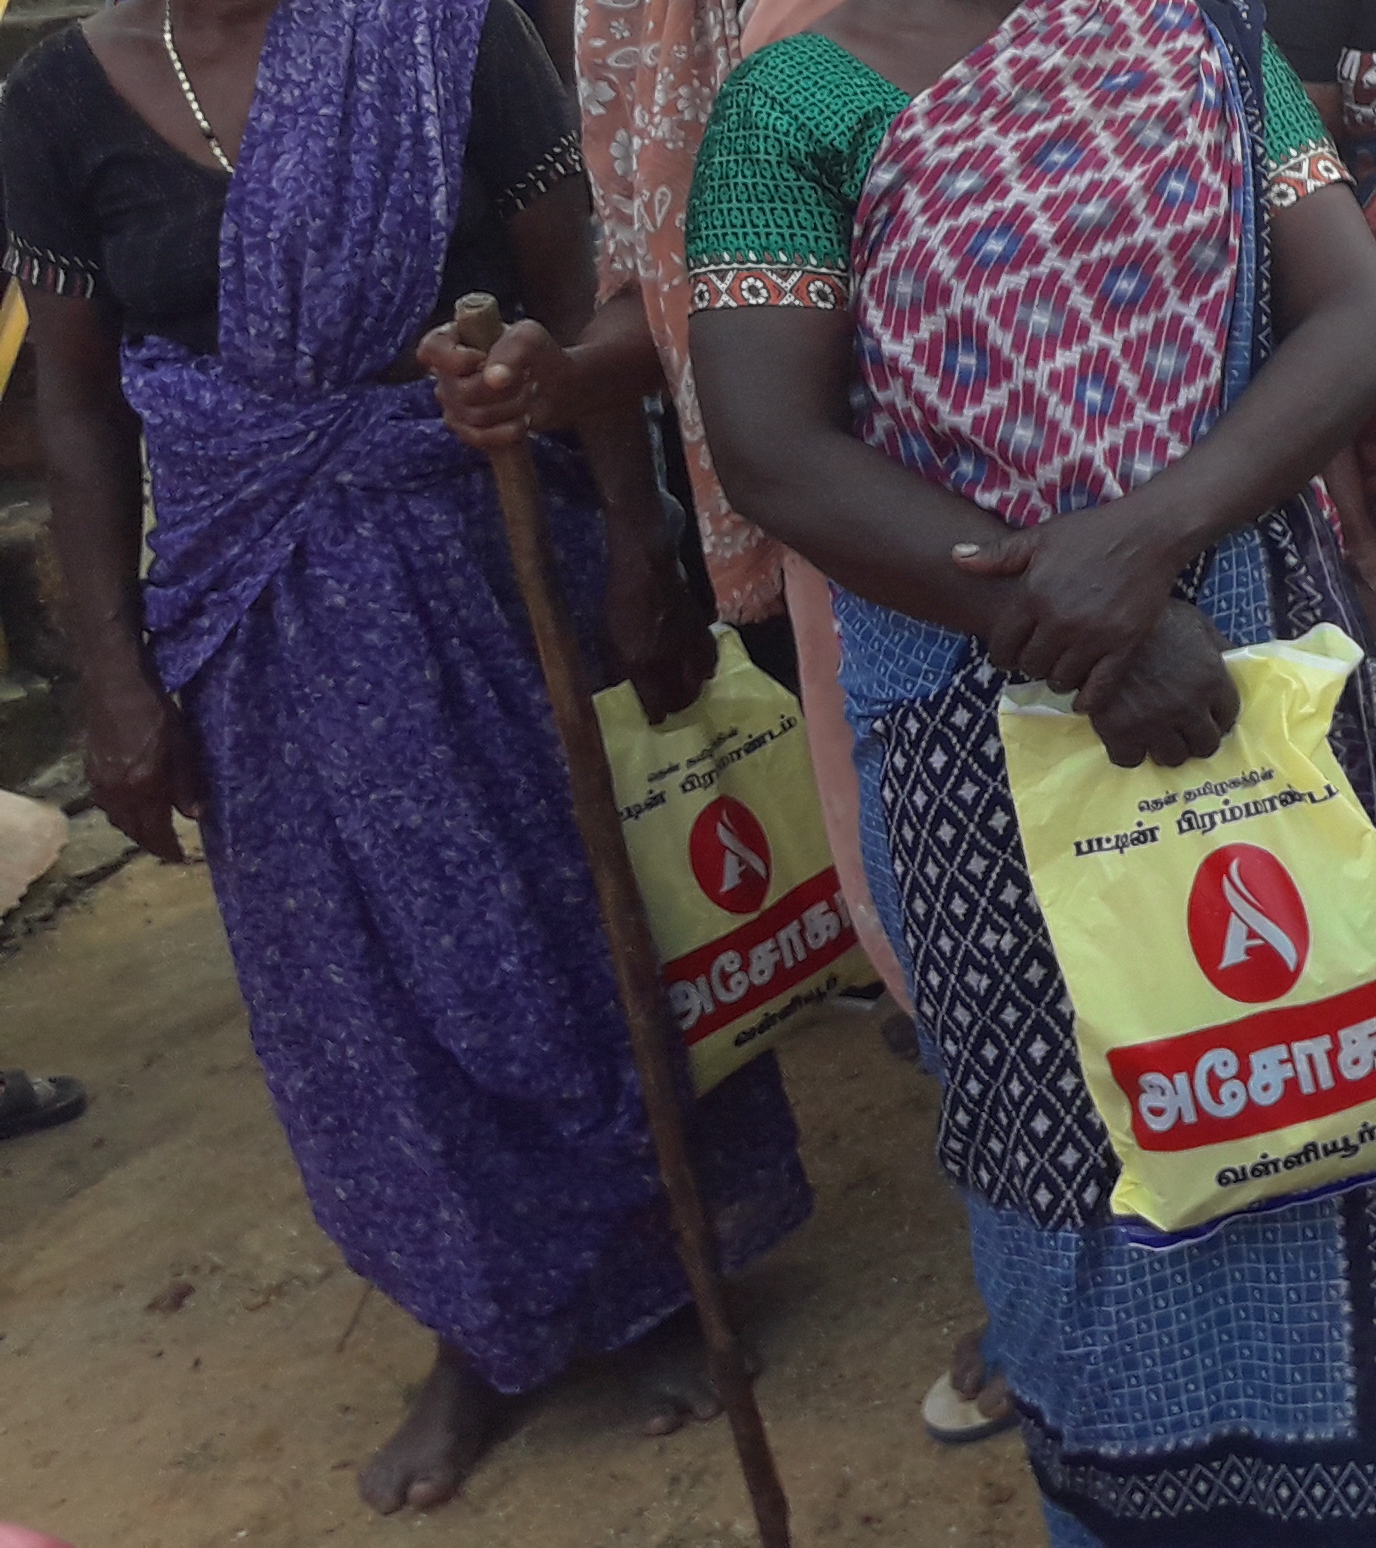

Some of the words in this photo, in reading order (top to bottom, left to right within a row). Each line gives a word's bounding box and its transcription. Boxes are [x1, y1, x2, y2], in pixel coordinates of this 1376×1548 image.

[1138, 791, 1179, 812] தென்
[1073, 820, 1161, 856] பட்டின்
[1219, 857, 1298, 971] A
